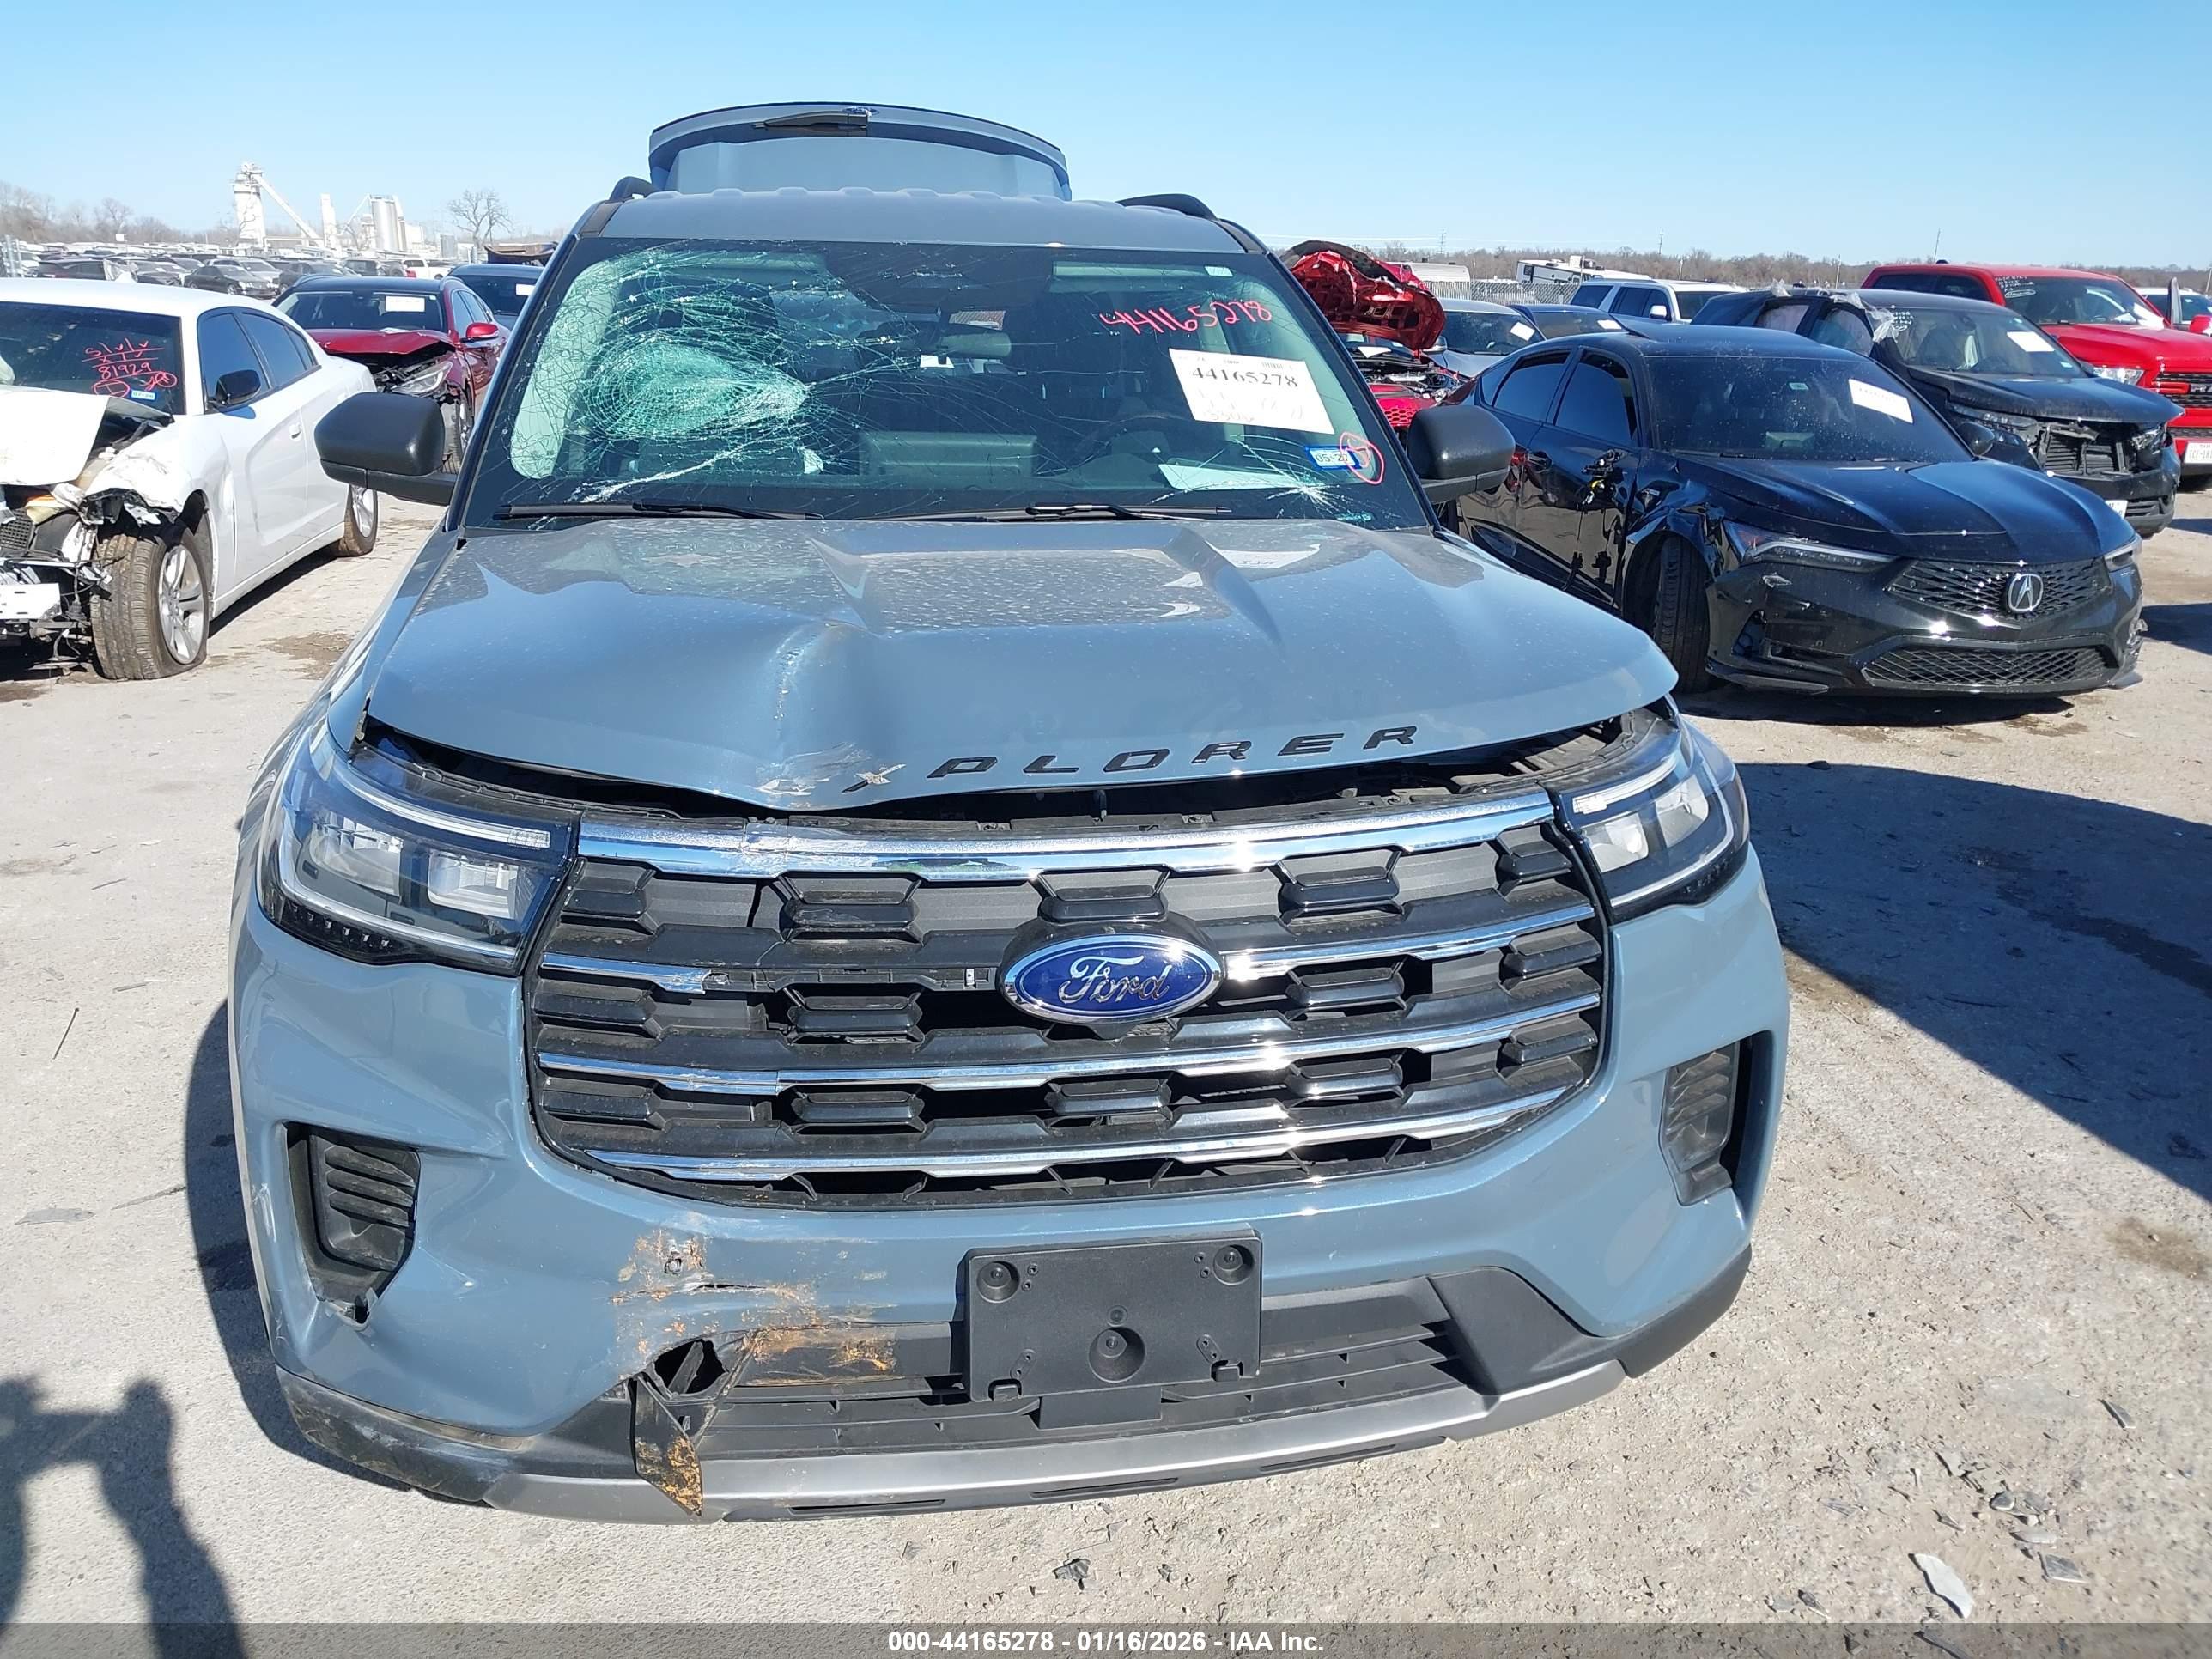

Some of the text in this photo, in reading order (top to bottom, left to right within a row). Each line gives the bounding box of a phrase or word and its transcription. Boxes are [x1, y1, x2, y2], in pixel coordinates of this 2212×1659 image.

[1099, 301, 1272, 334] 44165278
[98, 362, 152, 380] 81929
[1193, 367, 1298, 387] 44165278
[1058, 955, 1173, 1004] Ford
